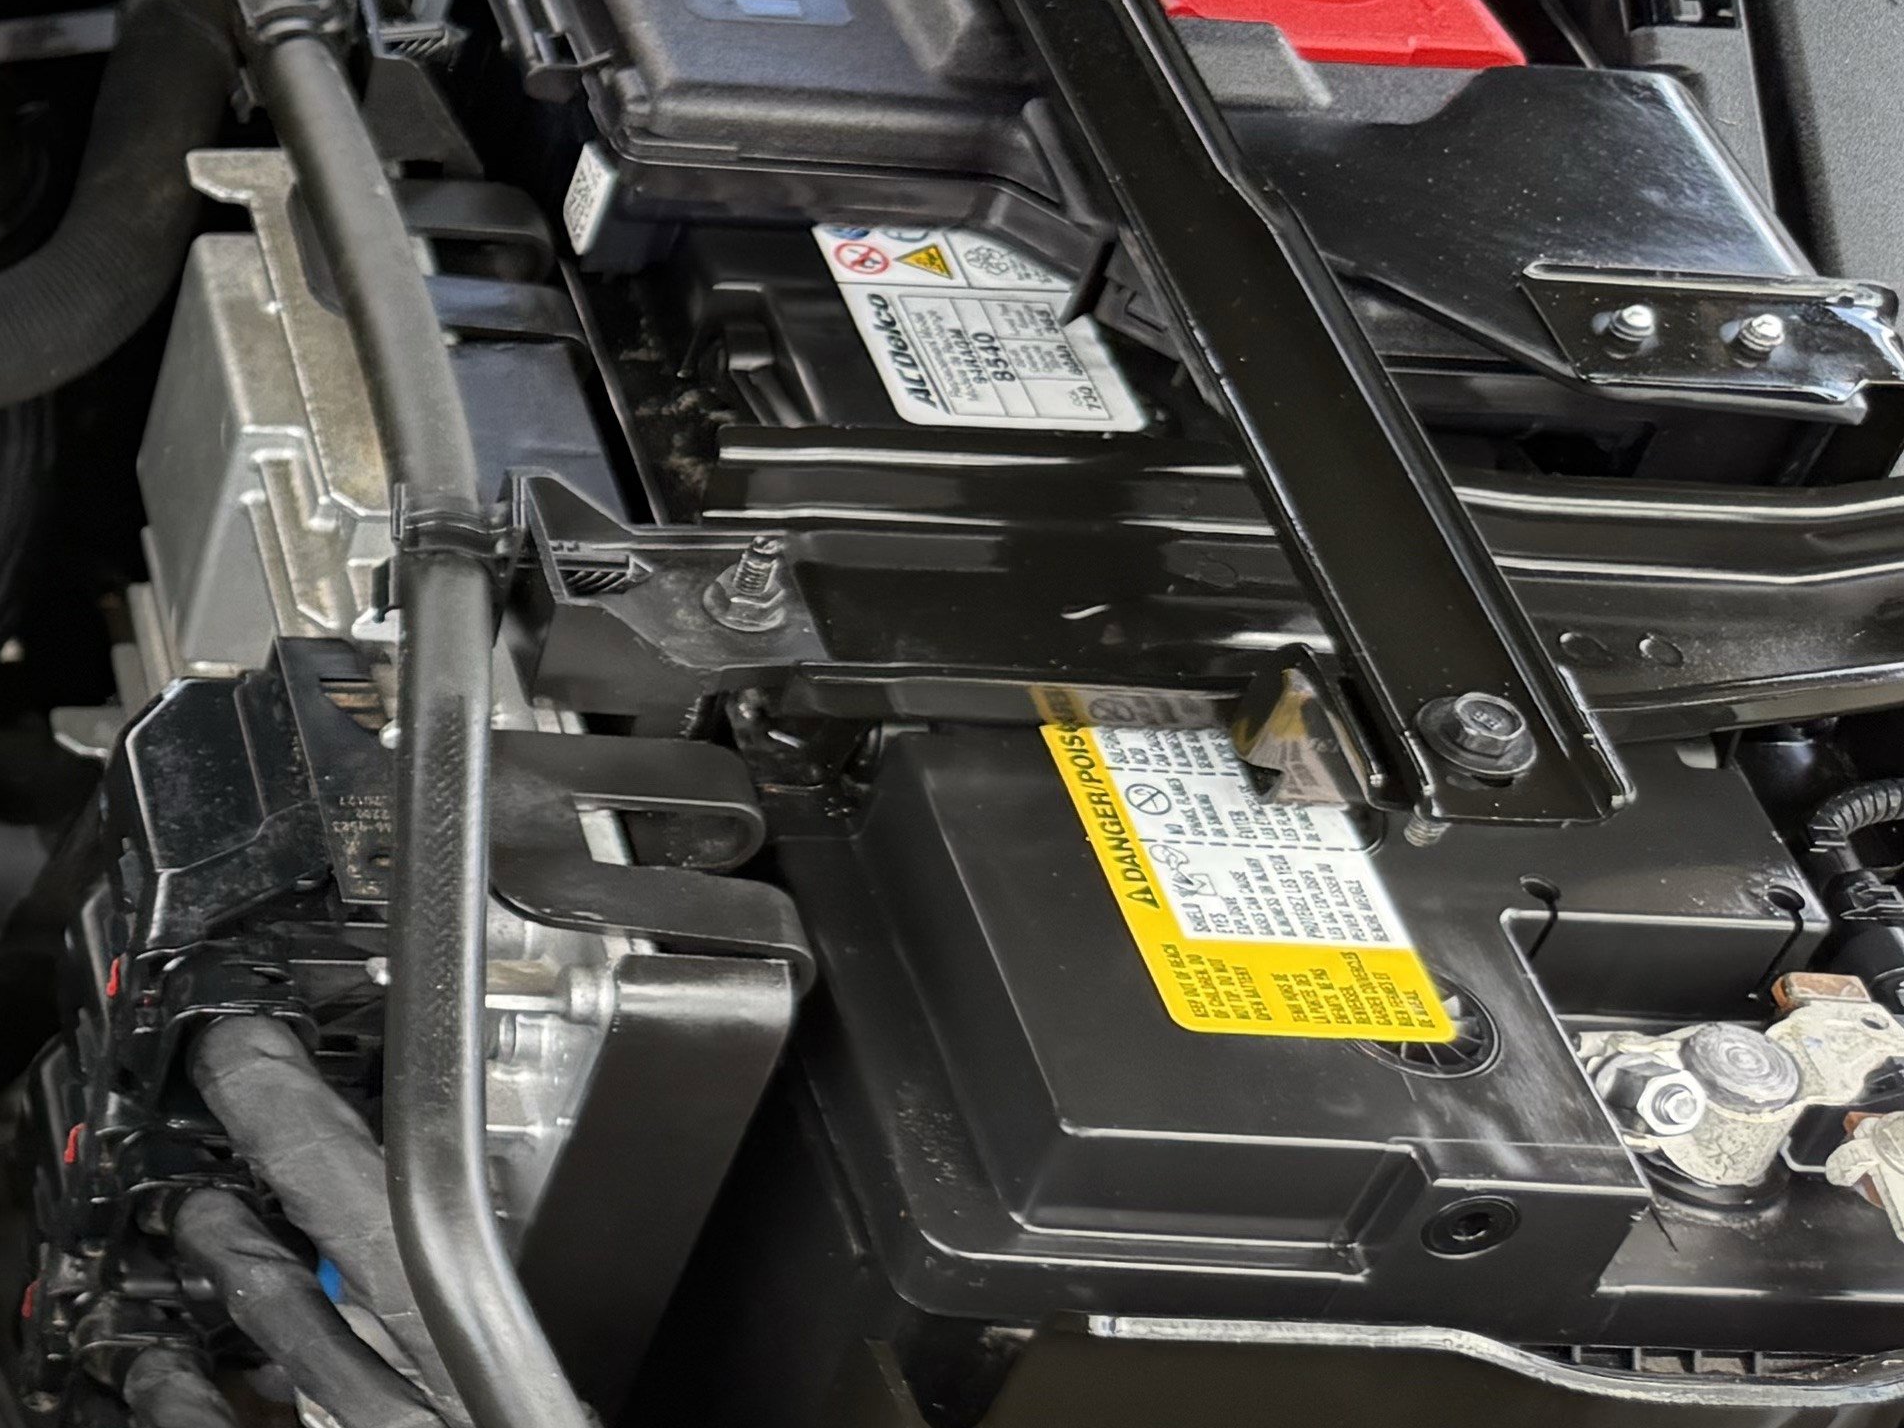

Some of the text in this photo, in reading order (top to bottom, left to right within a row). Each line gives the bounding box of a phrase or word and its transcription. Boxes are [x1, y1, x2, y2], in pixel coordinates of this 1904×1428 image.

[857, 292, 940, 408] ACDelco
[969, 332, 1017, 381] 8540
[1278, 878, 1302, 893] LES
[1207, 912, 1234, 933] EYES
[1326, 926, 1347, 939] LES
[1160, 943, 1186, 967] REACH
[1178, 982, 1200, 996] OUT
[1186, 999, 1210, 1017] KEEP
